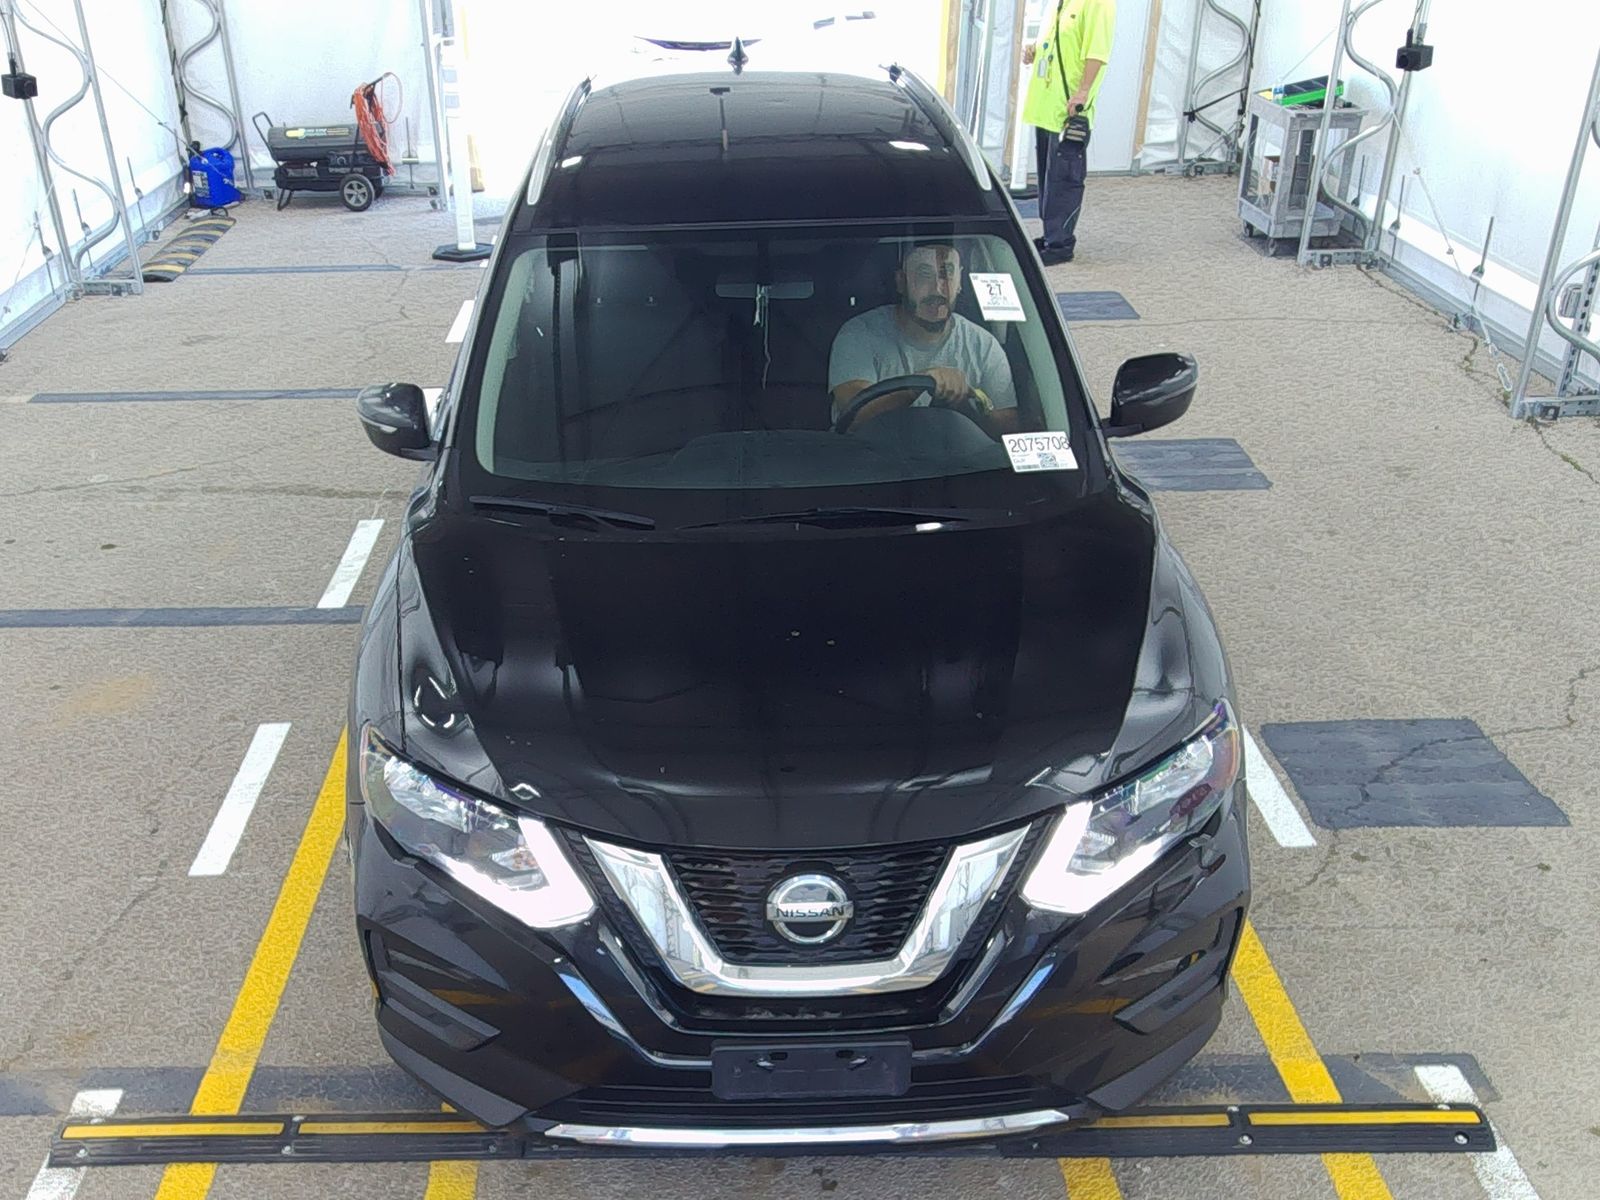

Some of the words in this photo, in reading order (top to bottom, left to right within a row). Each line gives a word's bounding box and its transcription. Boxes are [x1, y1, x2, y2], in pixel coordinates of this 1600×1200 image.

[986, 283, 1002, 296] 27
[1008, 436, 1072, 453] 2075708
[775, 905, 845, 918] NISSAN
